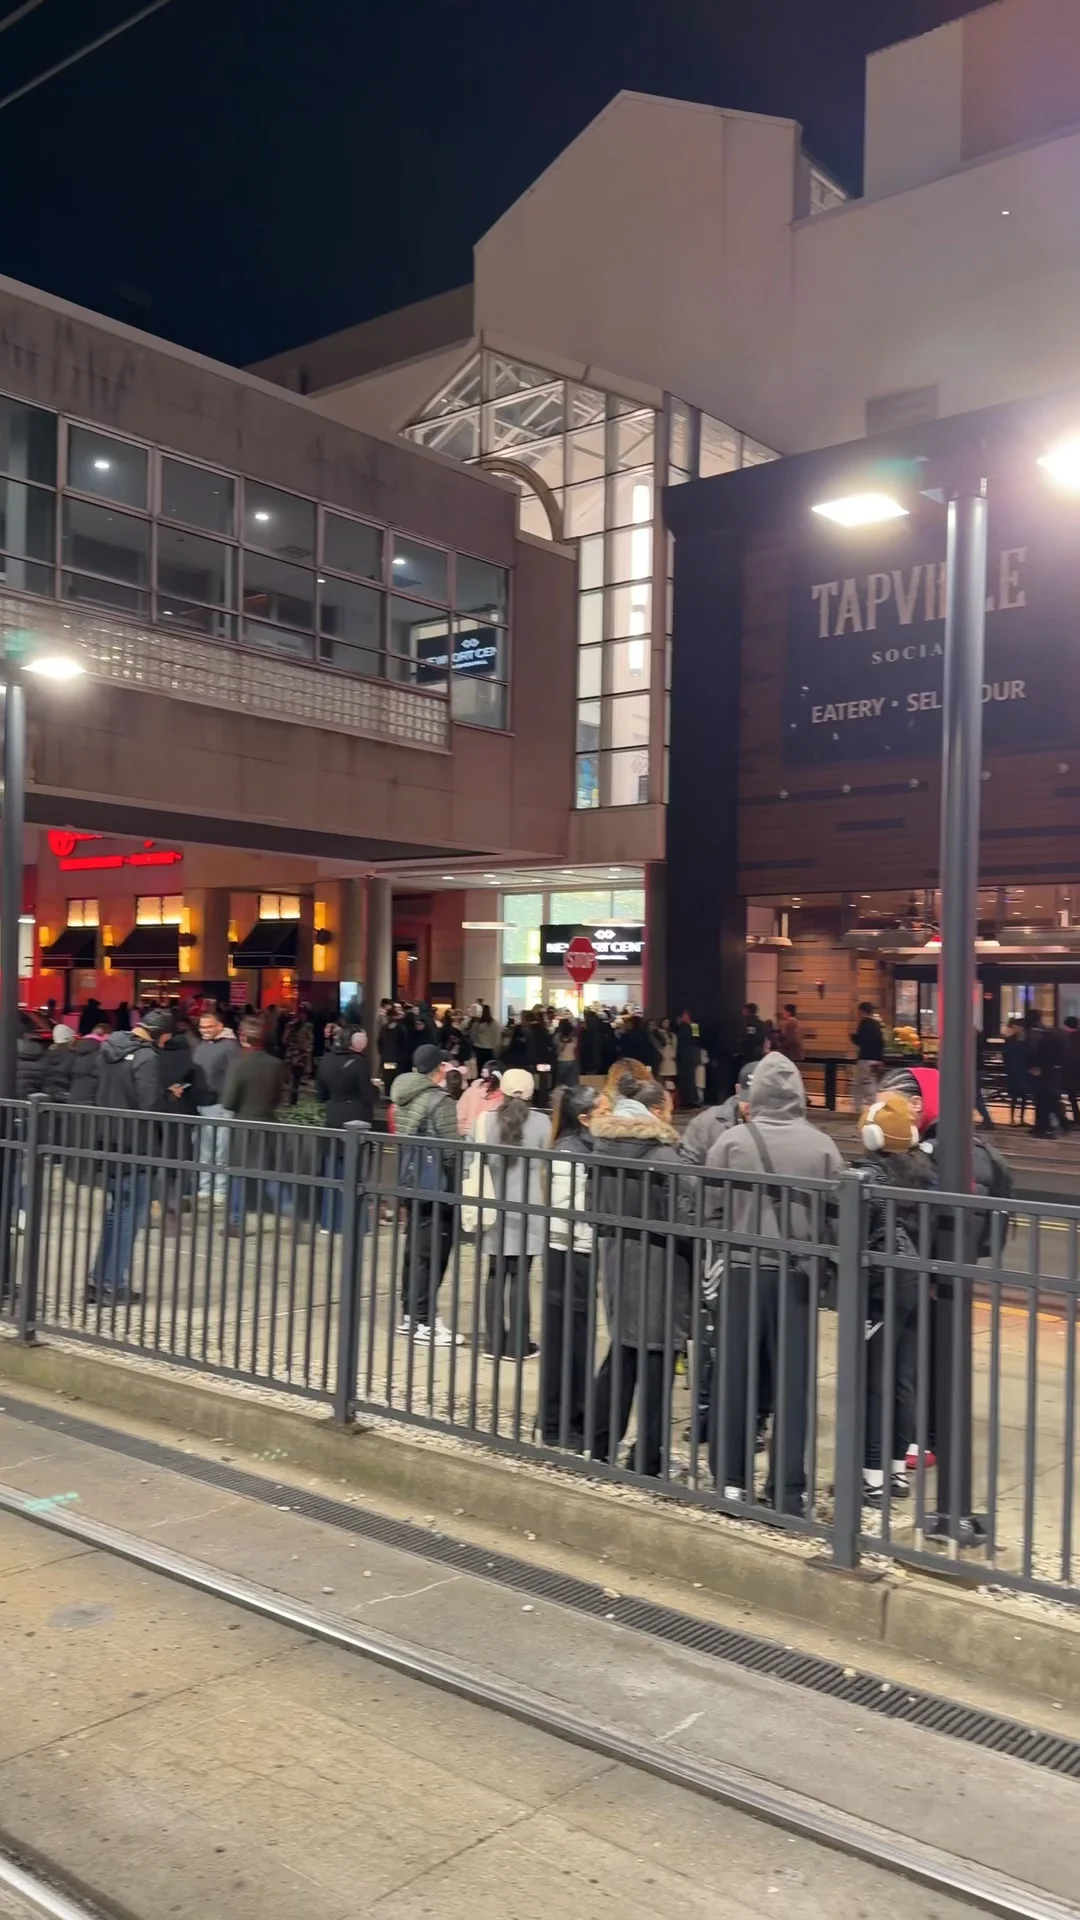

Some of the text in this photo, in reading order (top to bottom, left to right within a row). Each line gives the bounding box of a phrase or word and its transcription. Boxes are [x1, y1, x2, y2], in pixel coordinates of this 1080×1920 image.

[871, 643, 943, 665] SOCIA
[811, 697, 885, 723] EATERY
[566, 951, 595, 968] STOP
